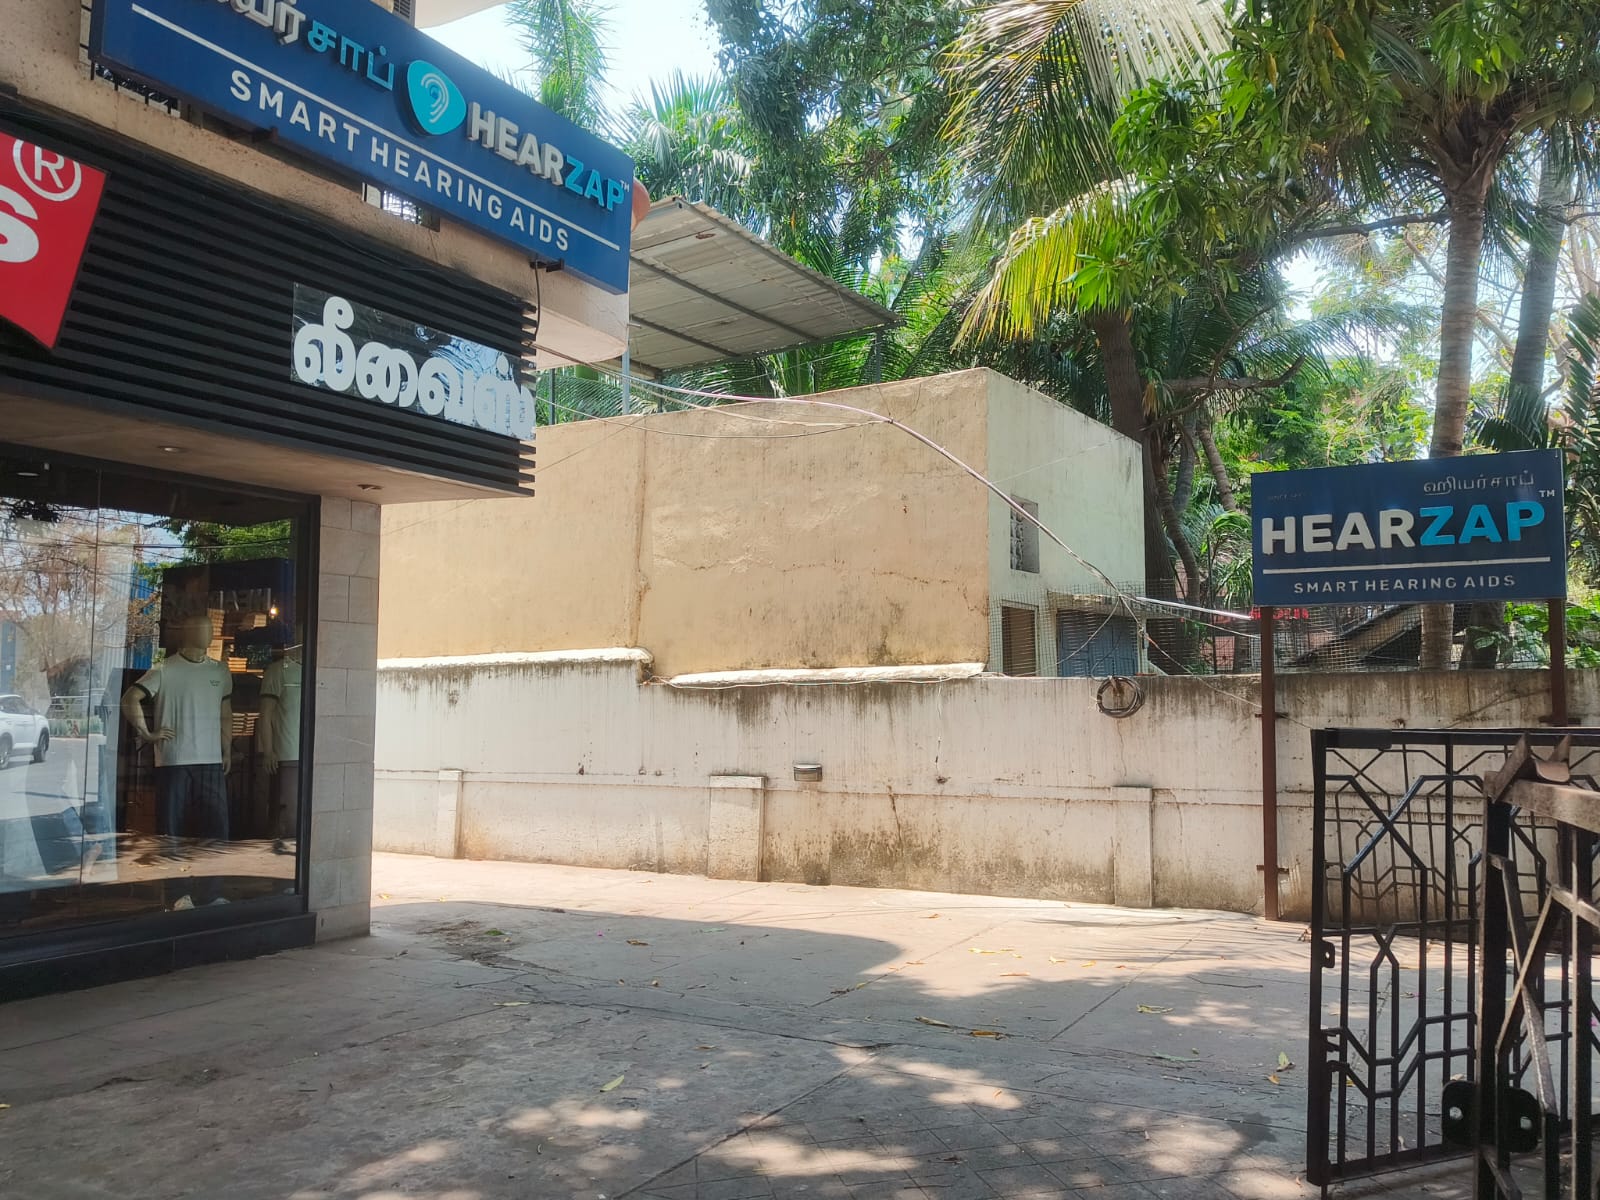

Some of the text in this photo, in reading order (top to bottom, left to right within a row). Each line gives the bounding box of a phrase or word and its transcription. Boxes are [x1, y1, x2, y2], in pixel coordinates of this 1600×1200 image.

[230, 70, 569, 251] SMART HEARING AIDS
[467, 102, 625, 212] HEARZAP
[1261, 501, 1545, 555] HEARZAP
[1293, 574, 1516, 594] SMART HEARING AIDS
